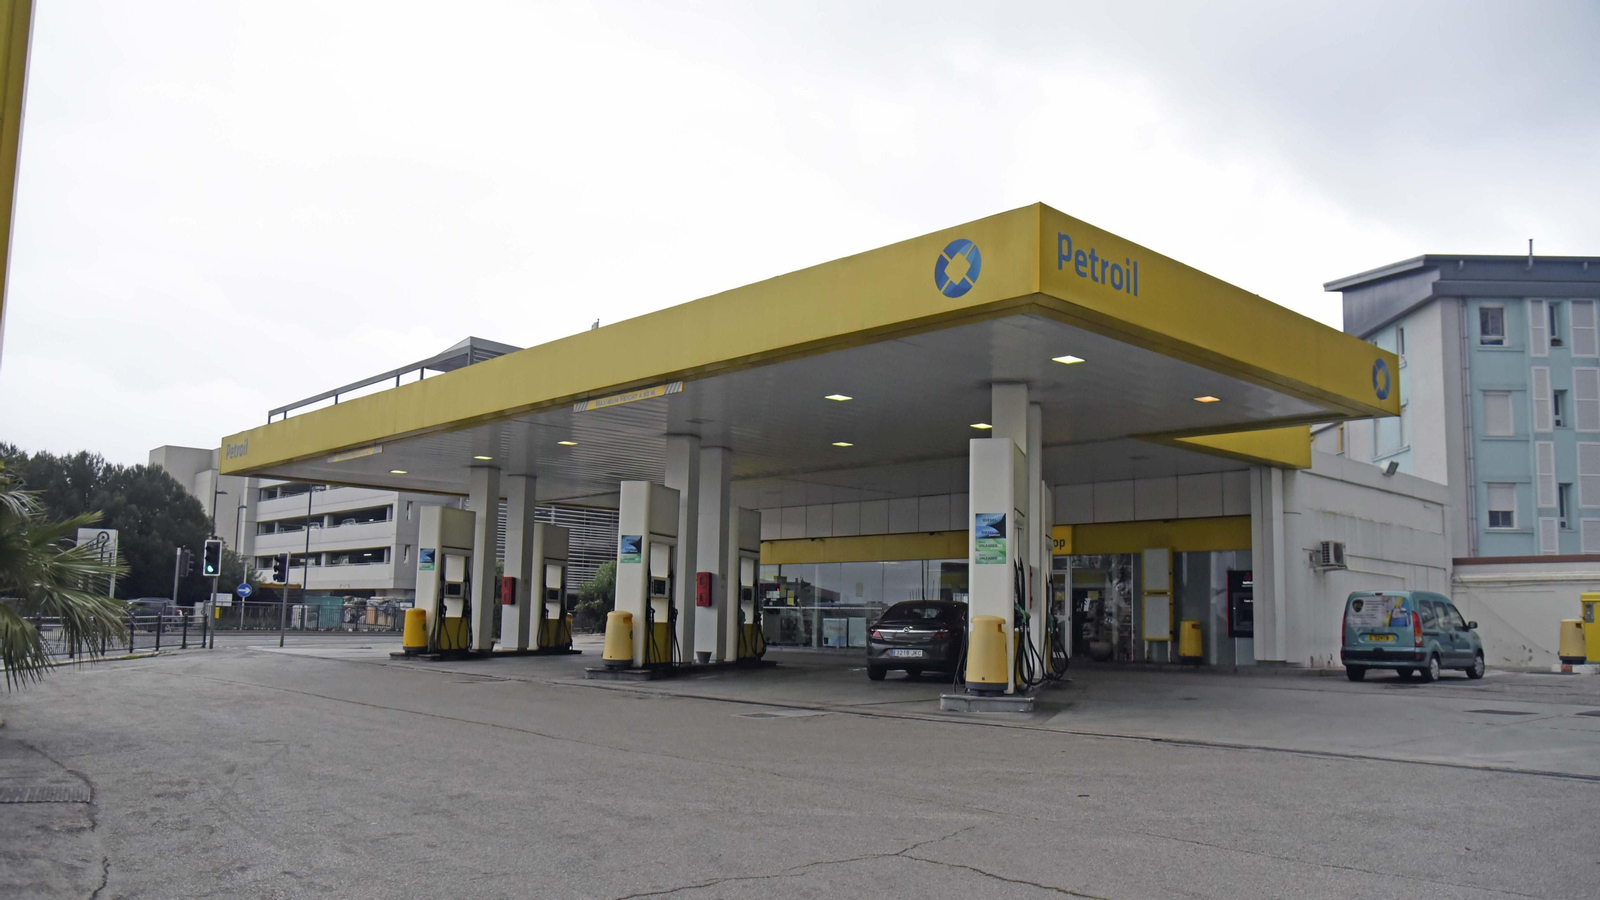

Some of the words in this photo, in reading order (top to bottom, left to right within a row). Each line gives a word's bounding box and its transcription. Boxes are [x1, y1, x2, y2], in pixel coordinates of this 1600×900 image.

[1057, 231, 1138, 297] Petroil
[226, 437, 248, 460] Petroil
[1052, 539, 1066, 550] op
